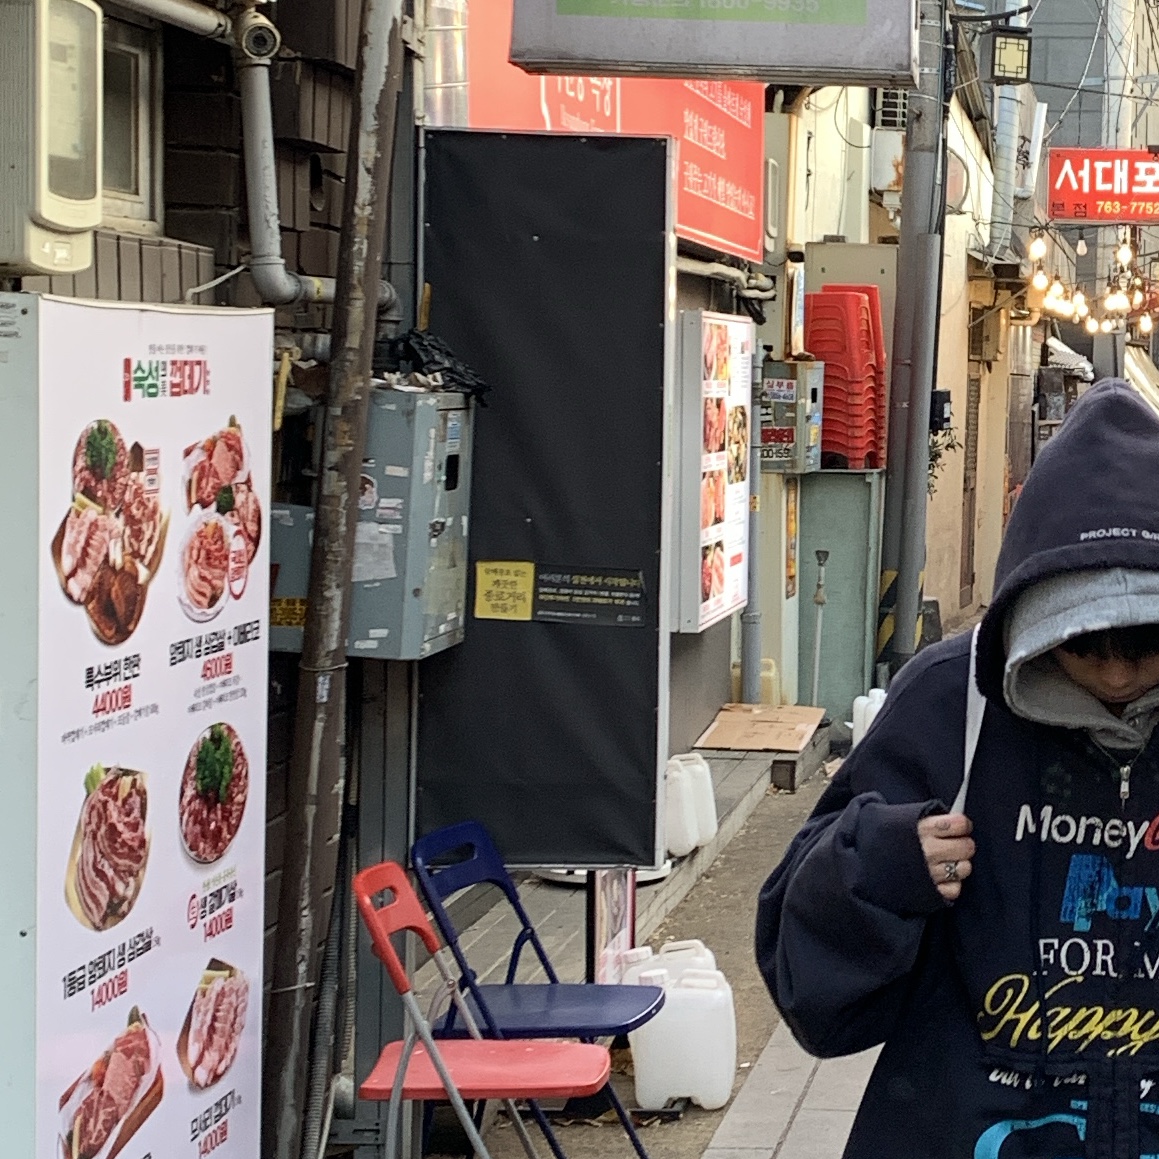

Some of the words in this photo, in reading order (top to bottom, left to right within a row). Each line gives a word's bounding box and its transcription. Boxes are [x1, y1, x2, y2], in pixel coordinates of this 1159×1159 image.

[133, 360, 160, 398] 숙성
[1080, 527, 1137, 541] PROJECT
[85, 659, 122, 690] 특수부위
[92, 683, 132, 718] 44000원
[1015, 804, 1150, 860] Money
[1032, 937, 1118, 977] FOR
[62, 964, 86, 1000] 1등급
[91, 968, 129, 1013] 14000원
